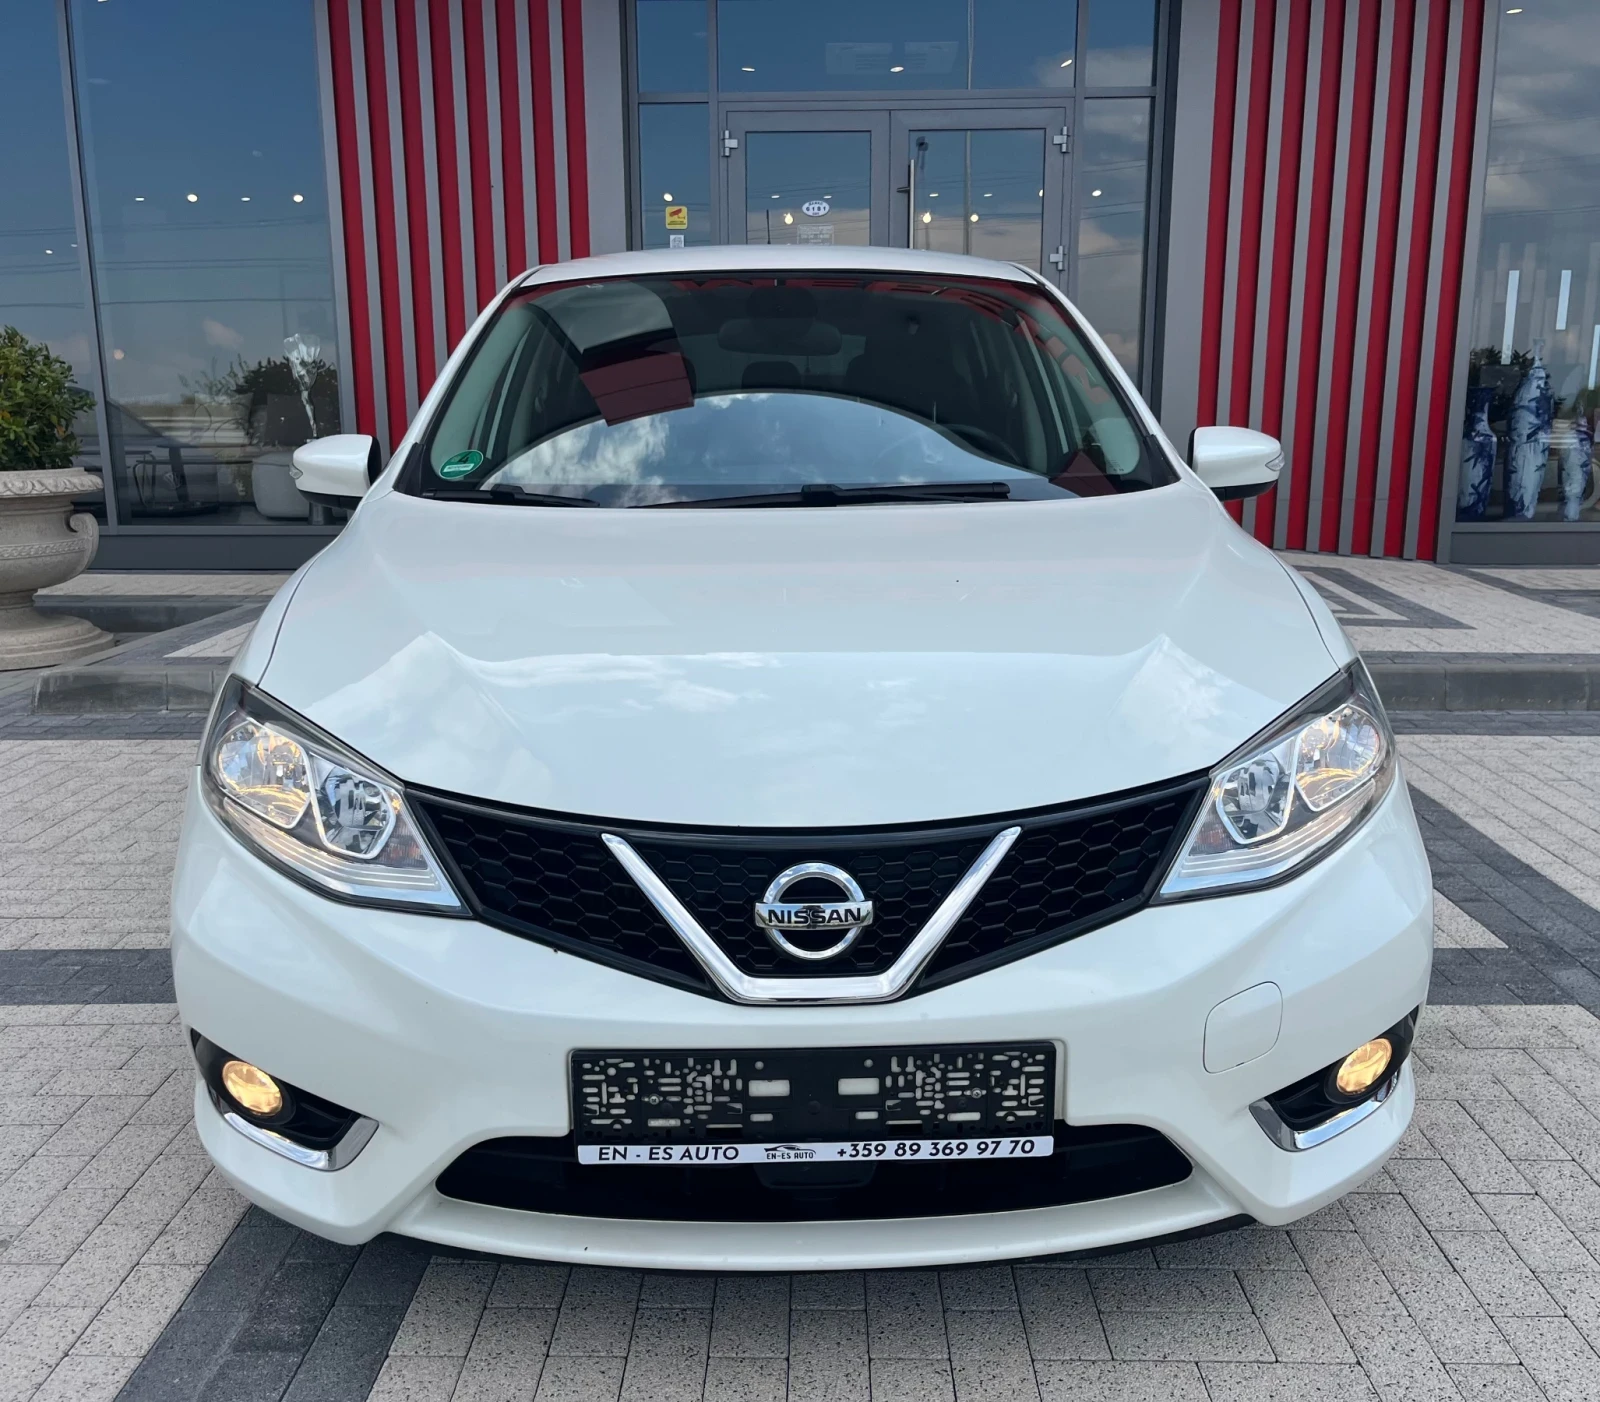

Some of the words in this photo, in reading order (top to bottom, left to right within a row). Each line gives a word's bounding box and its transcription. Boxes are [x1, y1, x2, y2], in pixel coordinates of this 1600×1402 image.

[768, 908, 861, 925] NISSAN
[598, 1146, 628, 1161] EN
[648, 1146, 674, 1161] ES
[679, 1145, 740, 1161] AUTO
[766, 1152, 792, 1160] EN-ES
[794, 1151, 814, 1159] AUTO
[837, 1143, 887, 1158] +359
[894, 1142, 922, 1157] 89
[929, 1141, 969, 1157] 369
[976, 1140, 1003, 1156] 97
[1008, 1139, 1036, 1155] 70
